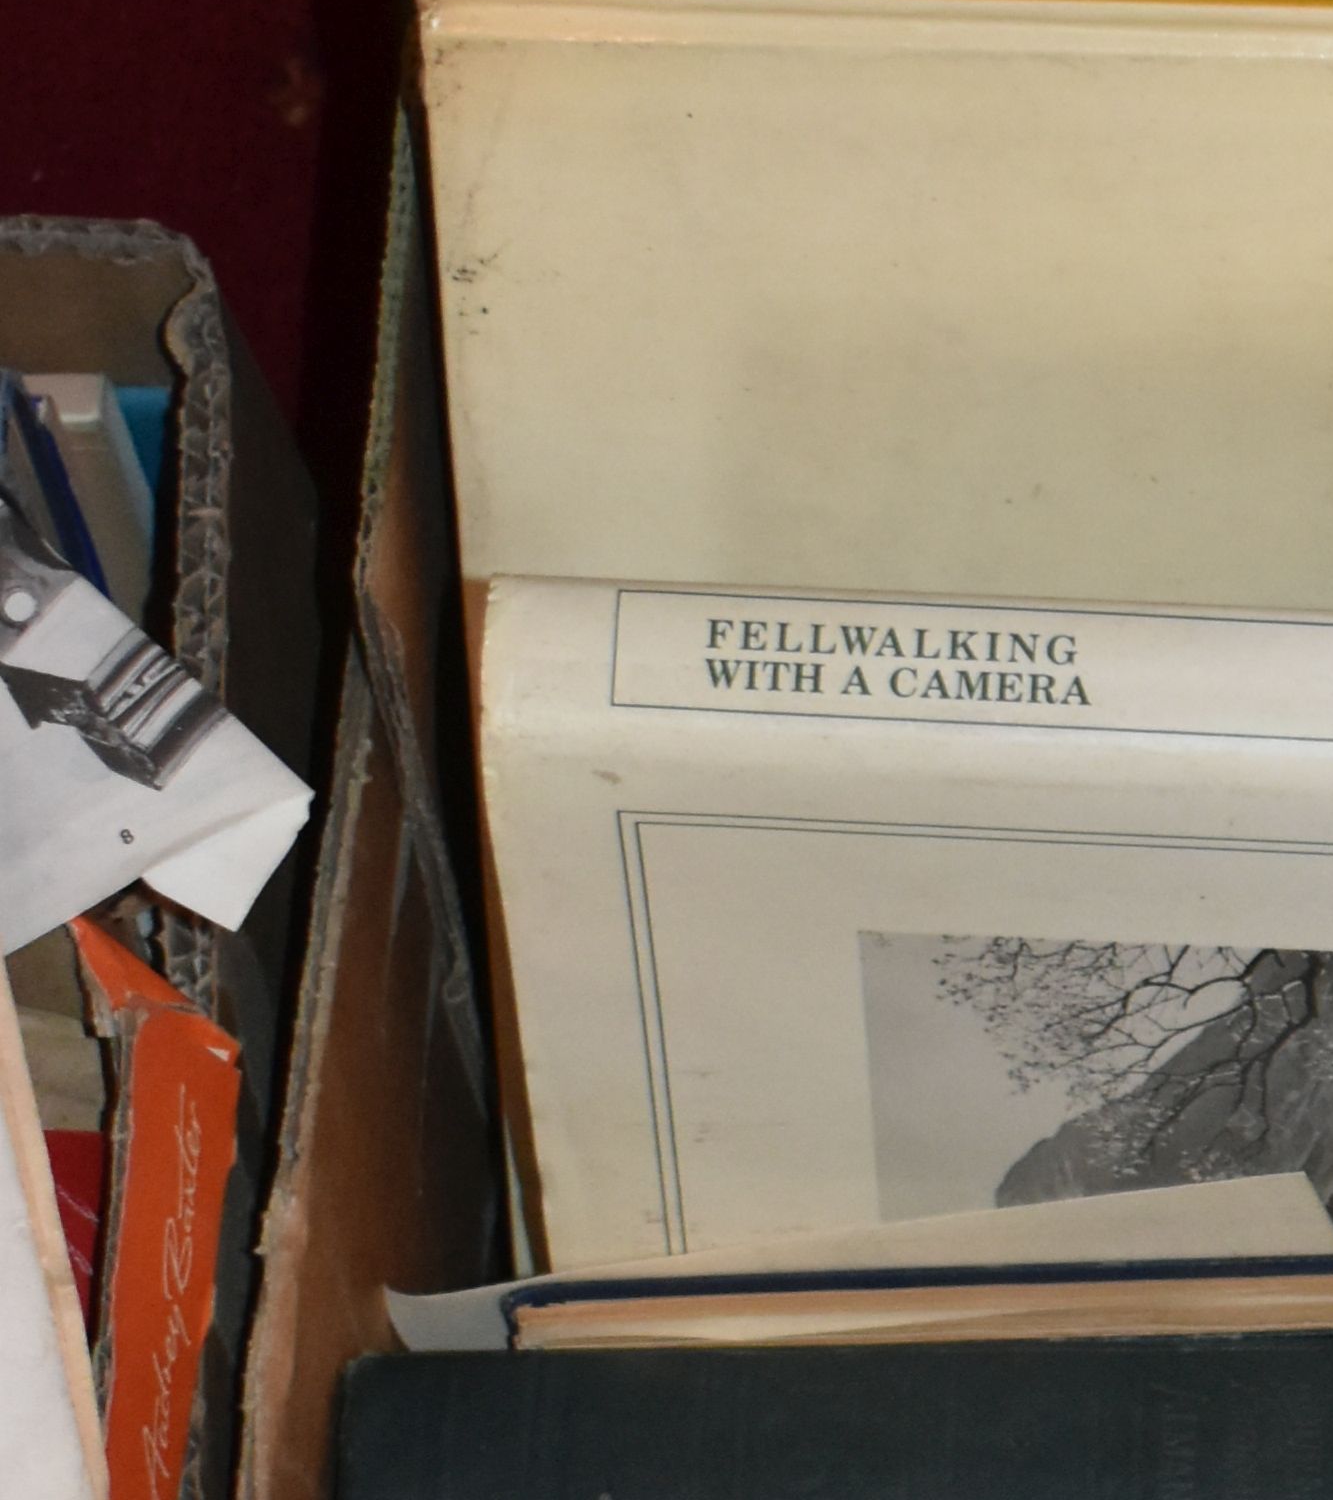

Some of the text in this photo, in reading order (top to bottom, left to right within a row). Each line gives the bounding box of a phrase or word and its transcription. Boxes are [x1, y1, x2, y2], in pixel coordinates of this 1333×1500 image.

[706, 617, 1079, 667] FELLWALKING
[705, 656, 1093, 708] WITH A CAMERA
